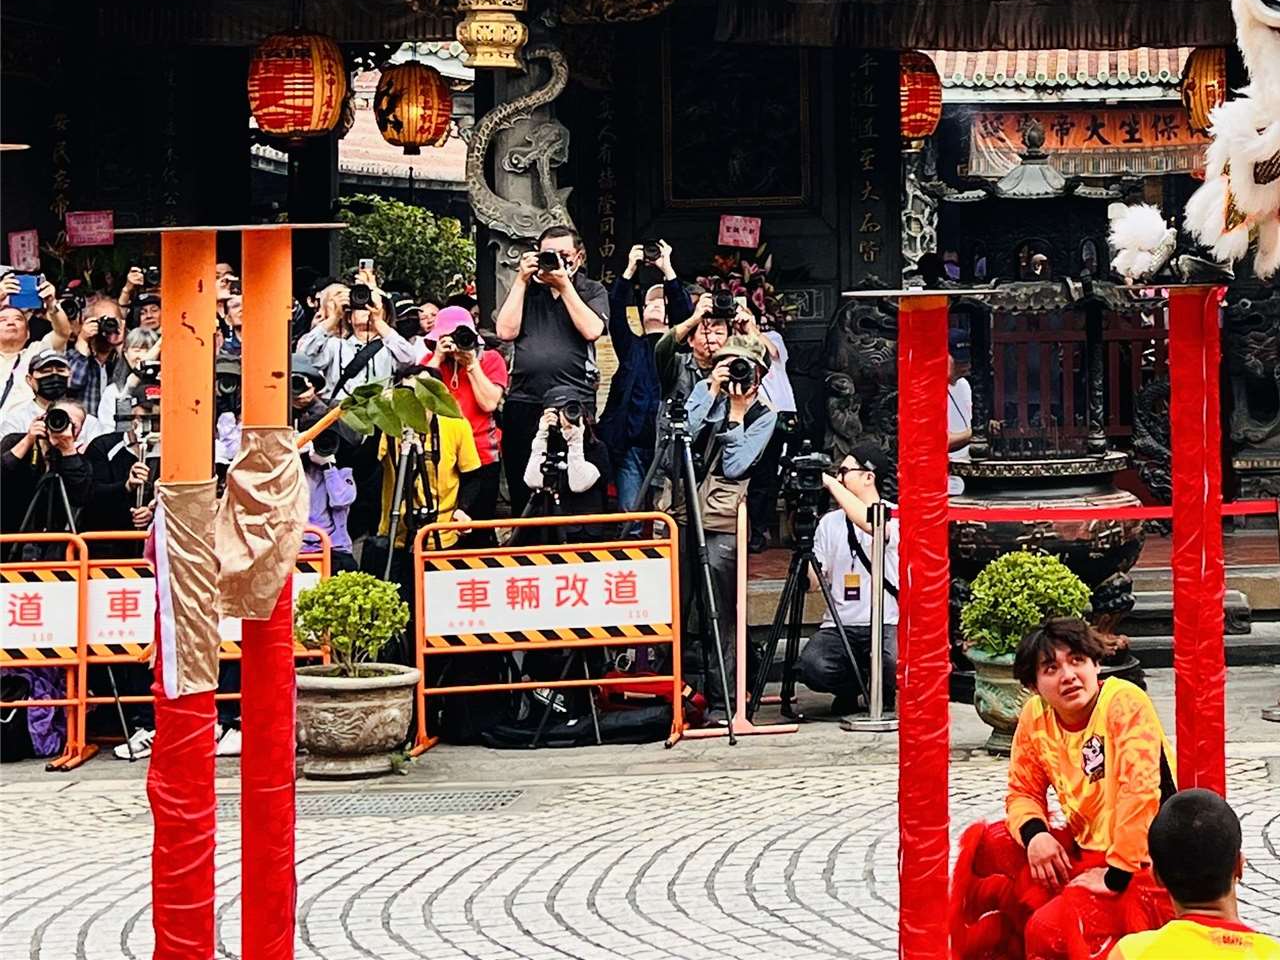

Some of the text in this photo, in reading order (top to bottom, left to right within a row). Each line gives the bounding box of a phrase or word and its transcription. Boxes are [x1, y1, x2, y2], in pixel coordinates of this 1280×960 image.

[107, 588, 141, 622] 車
[456, 570, 639, 612] 車輛改道
[8, 592, 43, 627] 道
[628, 609, 649, 619] 110
